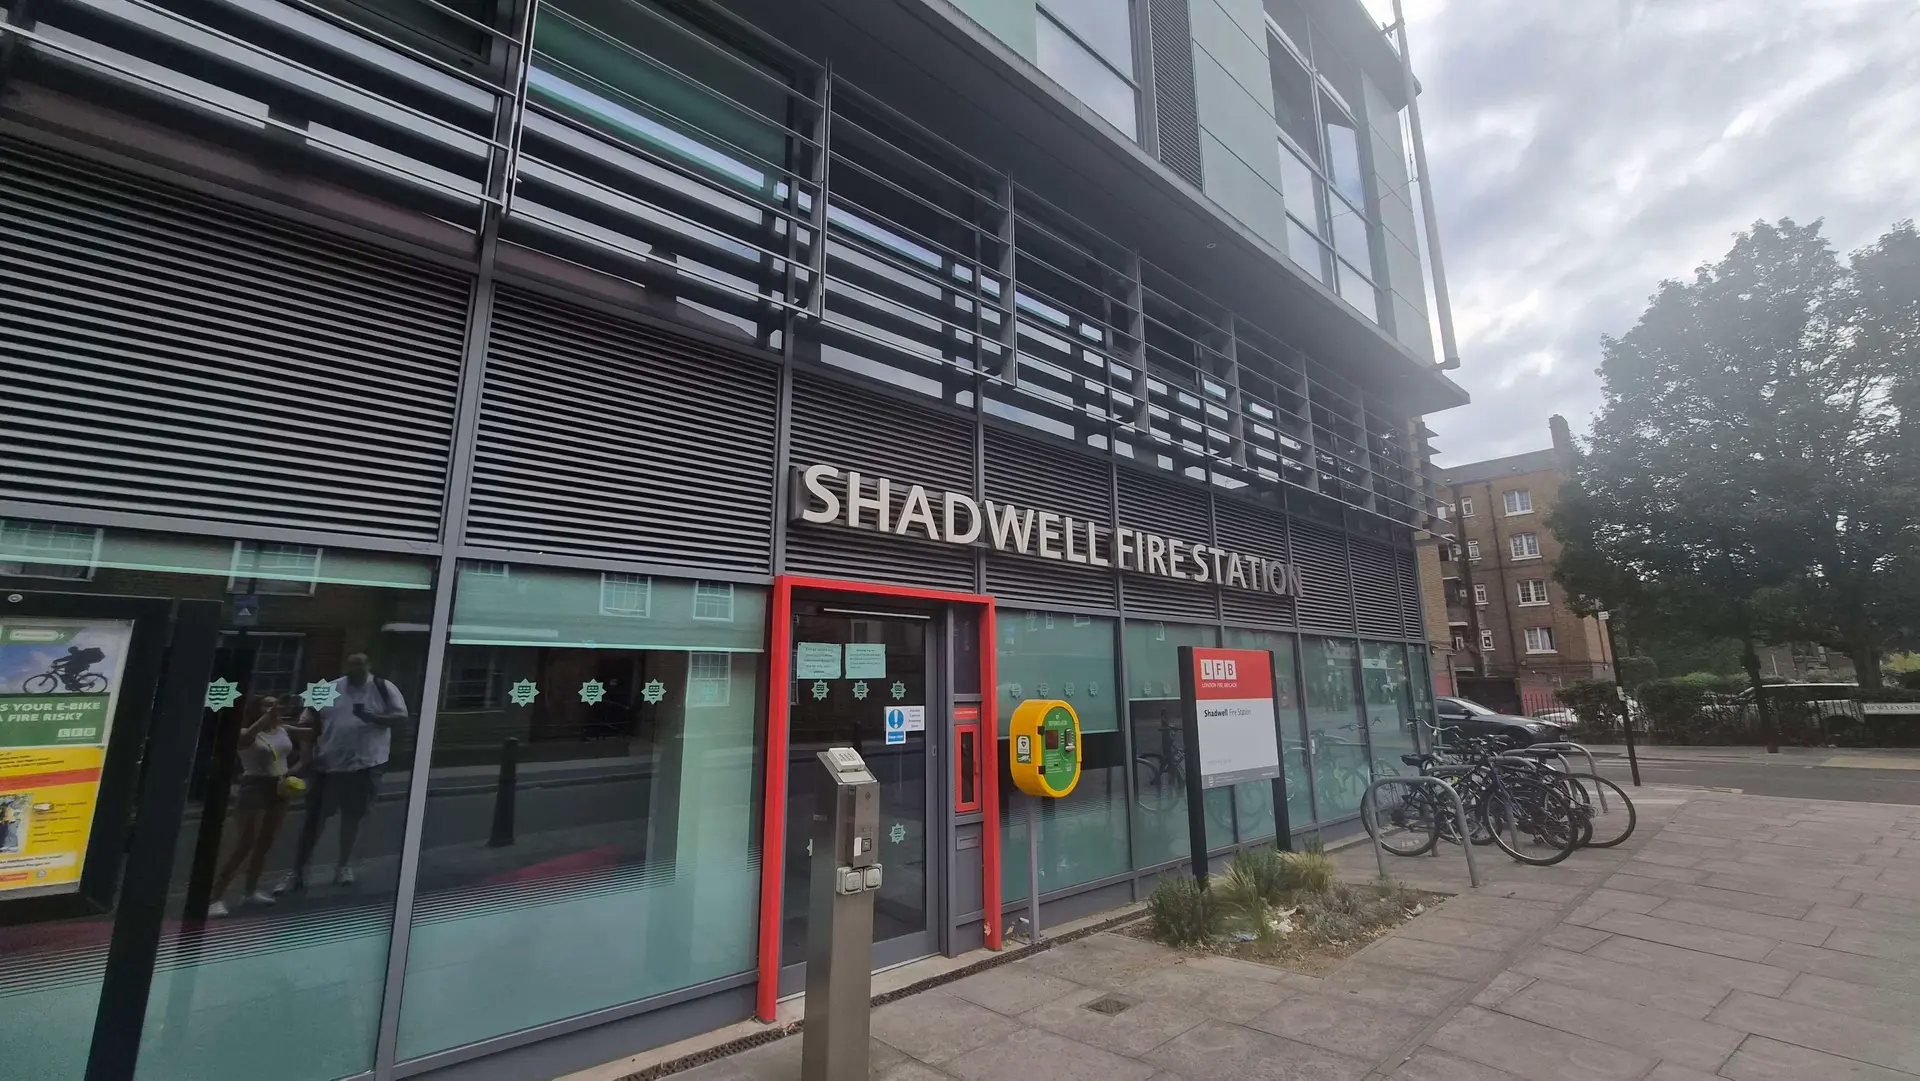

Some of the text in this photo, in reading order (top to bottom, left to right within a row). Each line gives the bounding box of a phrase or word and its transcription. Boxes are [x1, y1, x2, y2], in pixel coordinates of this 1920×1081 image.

[802, 464, 1304, 598] SHADWELL FIRE STATION
[1203, 662, 1234, 676] LFB
[0, 702, 100, 712] S YOUR E-BIKE
[8, 713, 39, 722] FIRE
[43, 712, 83, 721] RISK?
[1204, 708, 1252, 717] Shadwell Fire Station
